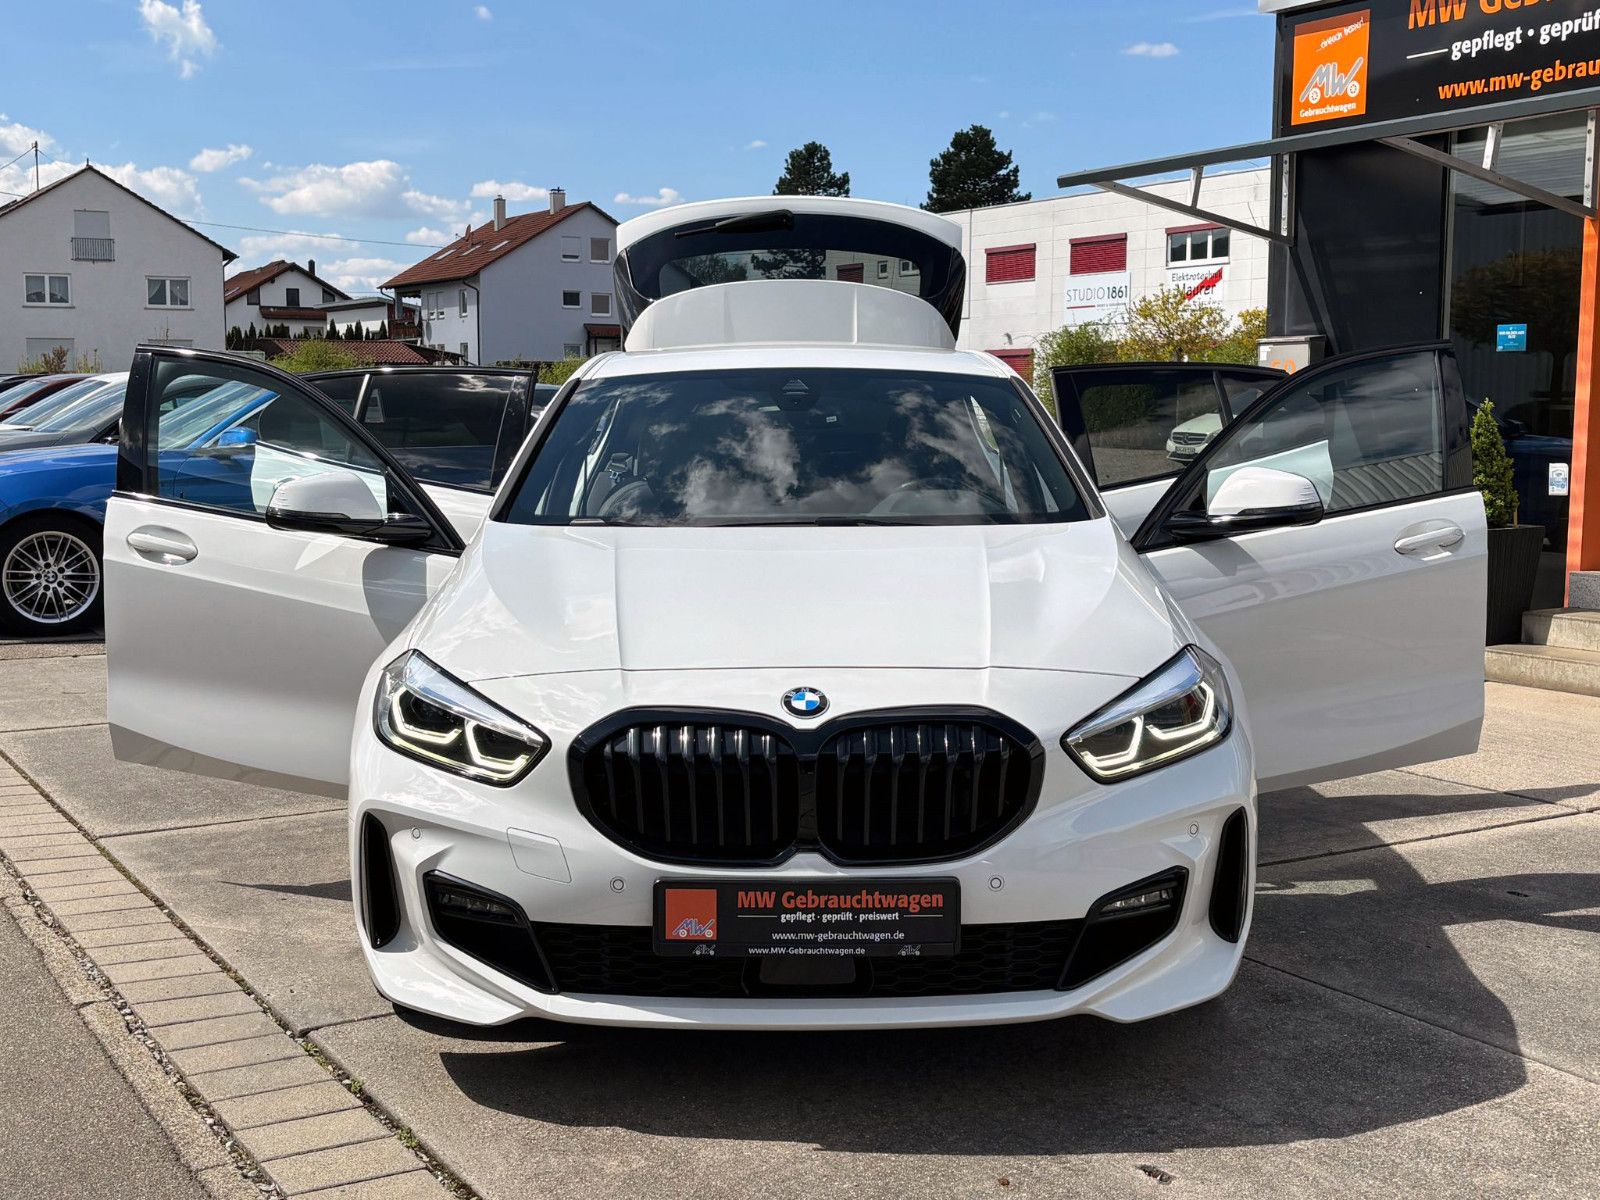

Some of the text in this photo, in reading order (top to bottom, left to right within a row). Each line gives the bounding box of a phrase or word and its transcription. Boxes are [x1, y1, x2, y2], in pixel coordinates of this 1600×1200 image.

[1451, 26, 1523, 61] gepflegt
[1299, 102, 1357, 118] Gebrauchtwagen
[1066, 285, 1128, 303] STUDIO 1861
[737, 889, 944, 913] MW Gebrauchtwagen
[780, 911, 899, 923] gepflegt geprüft preiswert
[771, 930, 905, 942] www.mw-gebrauchtwagen.de
[748, 947, 866, 956] www.MW-Gebrauchtwagen.de
